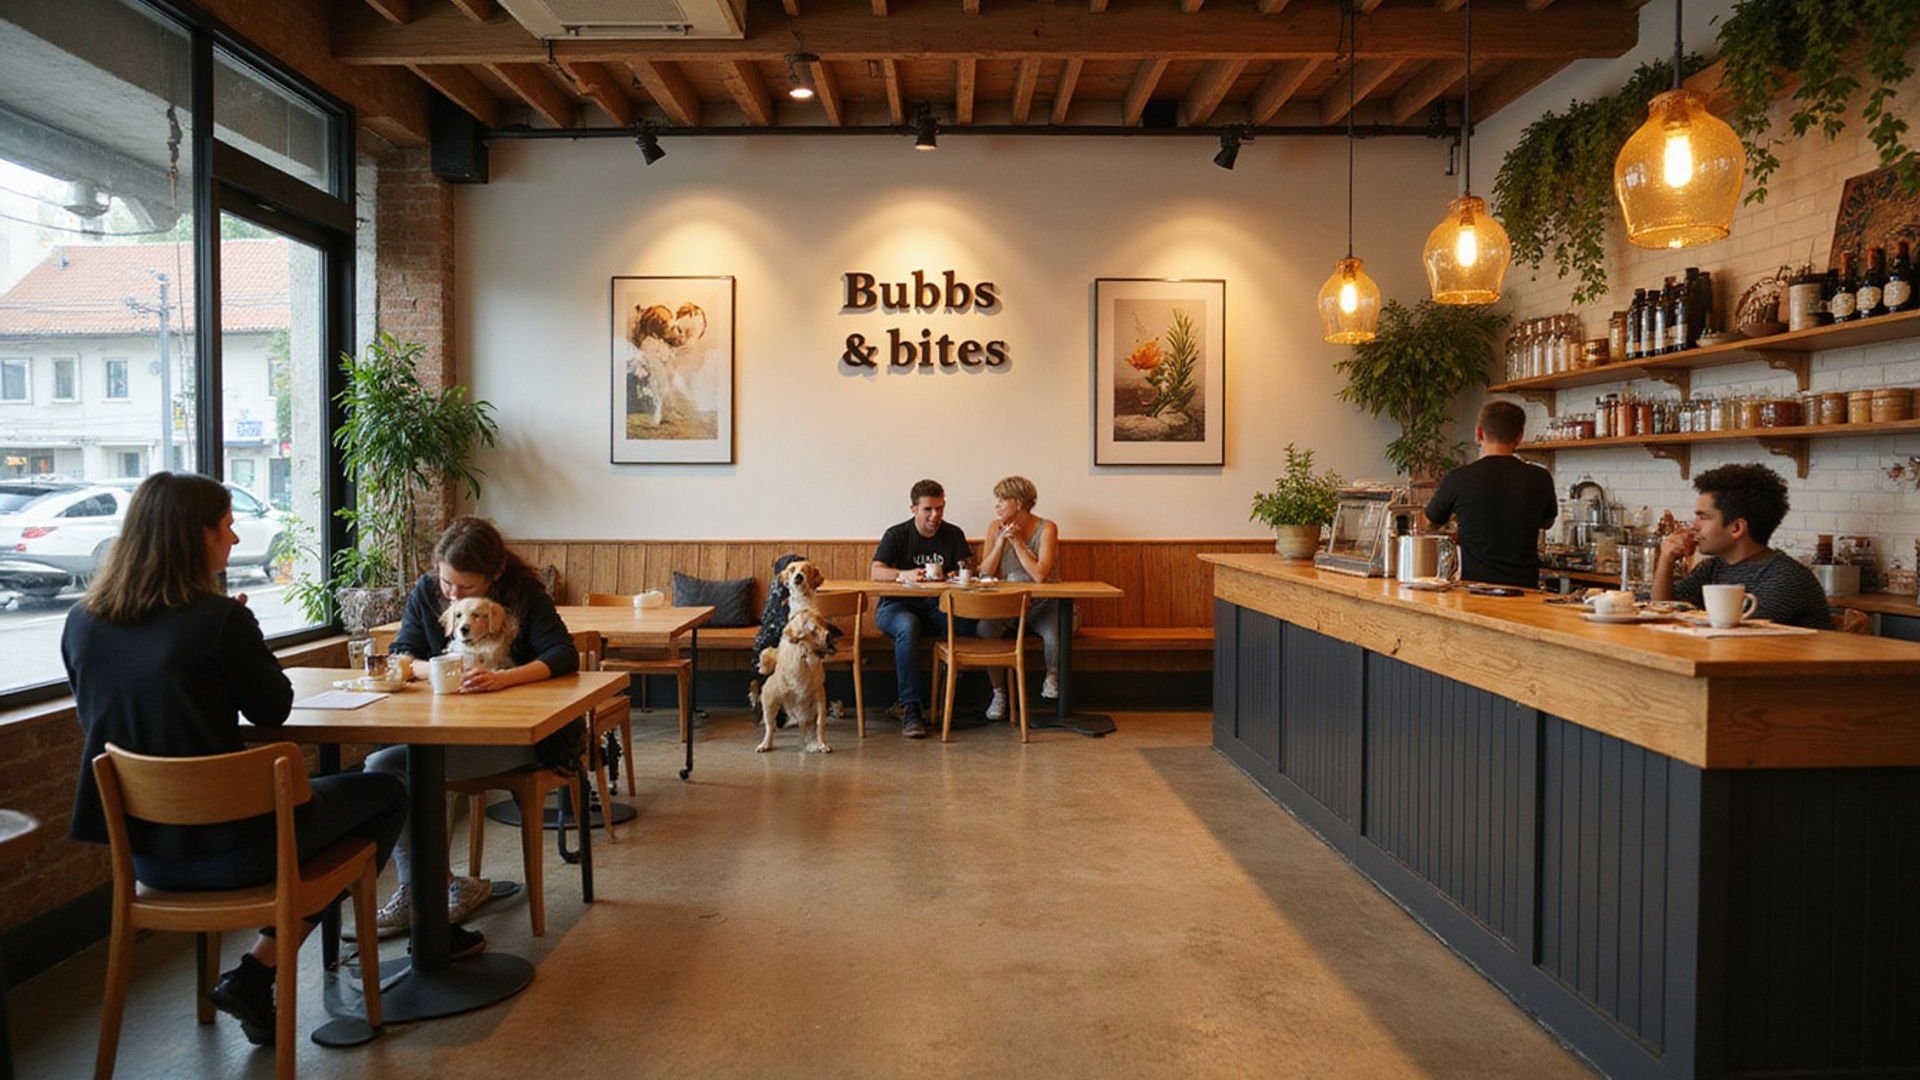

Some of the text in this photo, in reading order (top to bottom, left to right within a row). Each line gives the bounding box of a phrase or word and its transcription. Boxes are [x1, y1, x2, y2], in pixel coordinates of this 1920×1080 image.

[843, 269, 997, 309] Bubbs
[842, 328, 1006, 368] & bites
